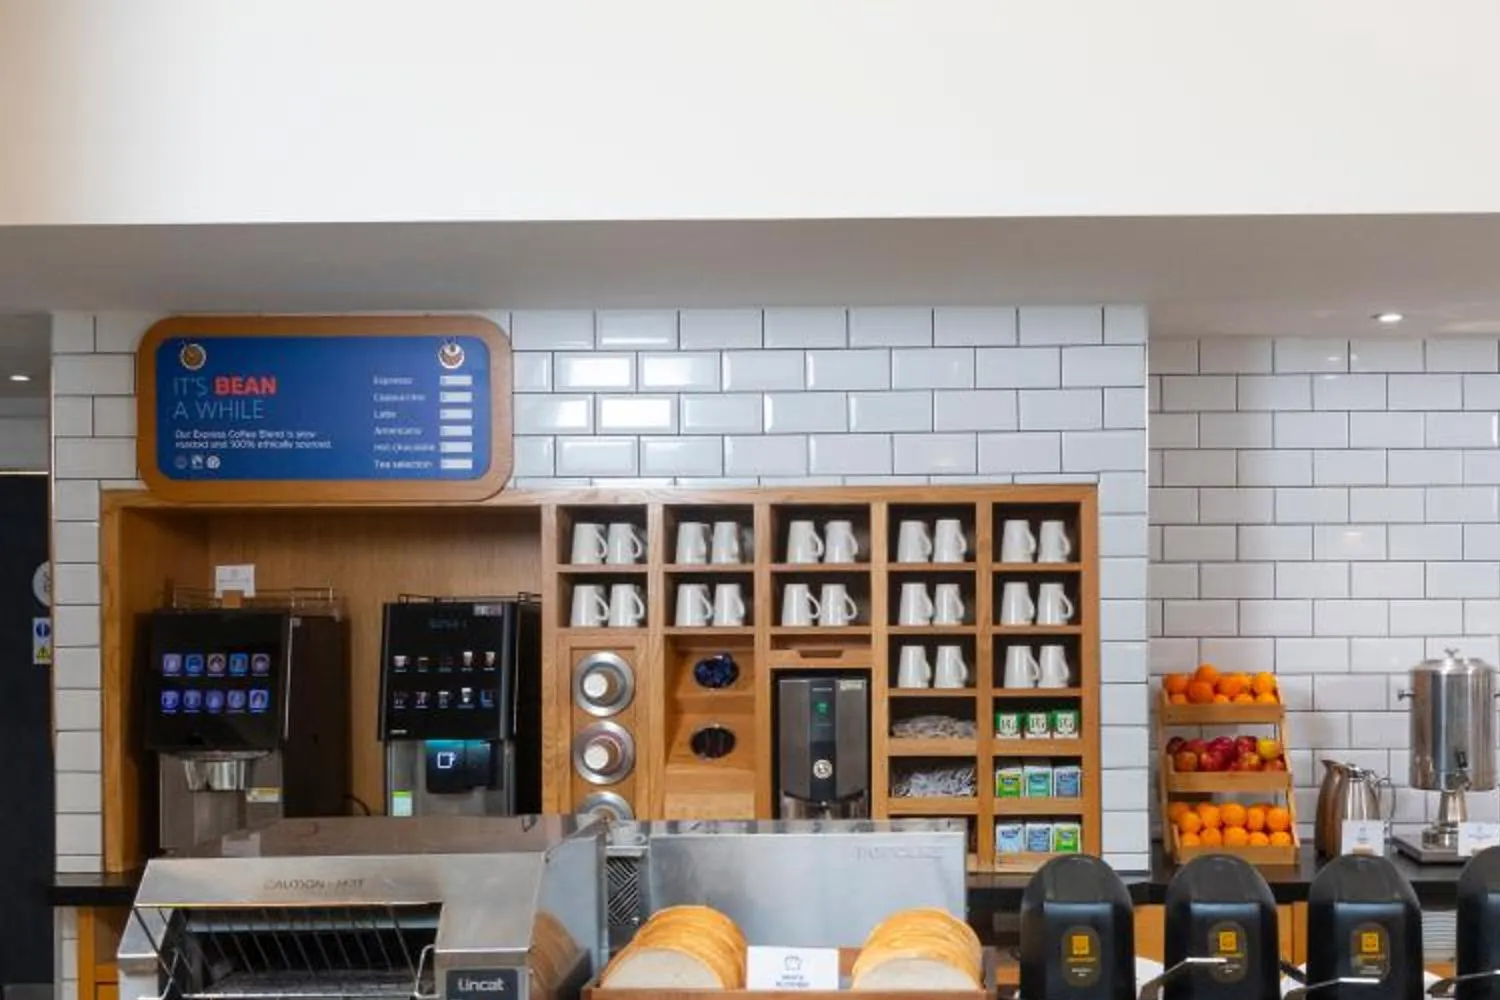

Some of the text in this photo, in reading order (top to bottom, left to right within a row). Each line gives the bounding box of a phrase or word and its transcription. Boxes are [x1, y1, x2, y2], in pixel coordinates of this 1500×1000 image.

[173, 376, 277, 396] IT'S BEAN
[373, 376, 413, 386] Espresso
[172, 399, 264, 420] A WHILE
[373, 410, 397, 419] Latte
[175, 430, 191, 439] Our
[193, 430, 226, 440] Express
[228, 430, 256, 439] Coffee
[259, 430, 284, 439] Blend
[229, 440, 255, 448] 100%
[257, 440, 293, 449] ethically
[374, 460, 433, 469] Tea selection
